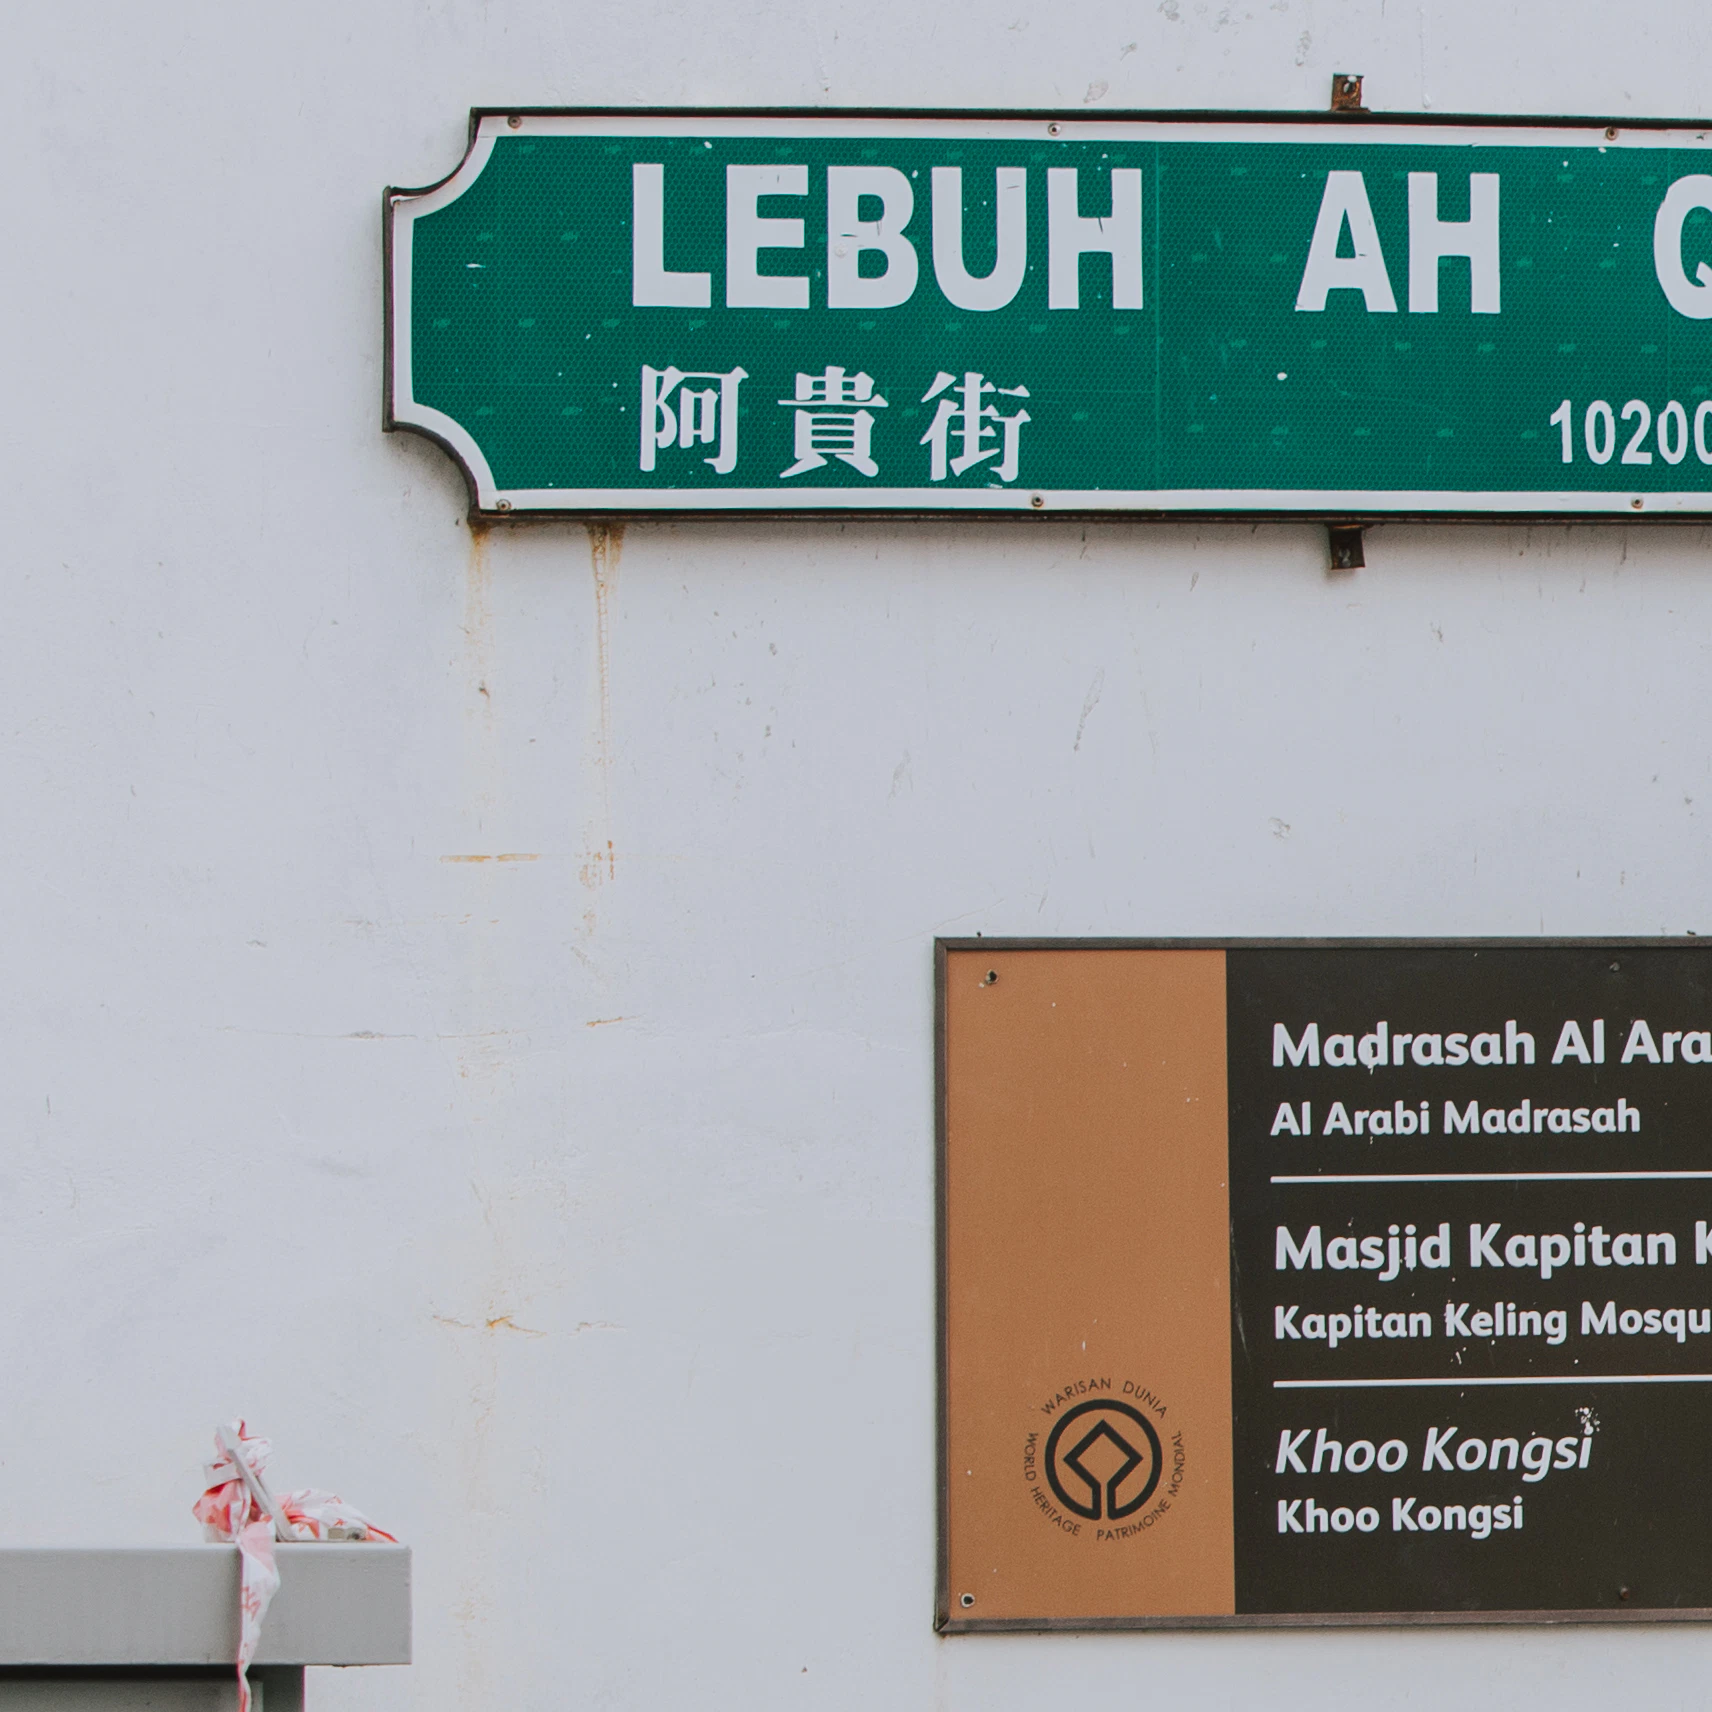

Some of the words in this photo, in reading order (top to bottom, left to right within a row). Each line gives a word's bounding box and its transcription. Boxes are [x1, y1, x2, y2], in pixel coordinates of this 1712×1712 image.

[633, 163, 1143, 311] LEBUH
[1295, 170, 1501, 314] AH
[640, 365, 1031, 482] 阿貴街
[1273, 1020, 1535, 1067] Madrasah
[1552, 1019, 1605, 1065] Al
[1271, 1102, 1311, 1136] Al
[1323, 1100, 1430, 1135] Arabi
[1444, 1098, 1640, 1134] Madrasah
[1275, 1222, 1451, 1281] Masjid
[1469, 1221, 1677, 1279] Kapitan
[1275, 1304, 1432, 1348] Kapitan
[1444, 1302, 1567, 1345] Keling
[1041, 1377, 1112, 1416] WARISAN
[1122, 1380, 1168, 1420] DUNIA
[1023, 1432, 1039, 1482] WORLD
[1275, 1427, 1408, 1474] Khoo
[1421, 1428, 1594, 1482] Kongsi
[1030, 1485, 1082, 1537] HERITAGE
[1095, 1498, 1171, 1541] PATRIMOINE
[1167, 1430, 1186, 1497] MONDIAL
[1277, 1497, 1380, 1533] Khoo
[1392, 1495, 1523, 1539] Kongsi
